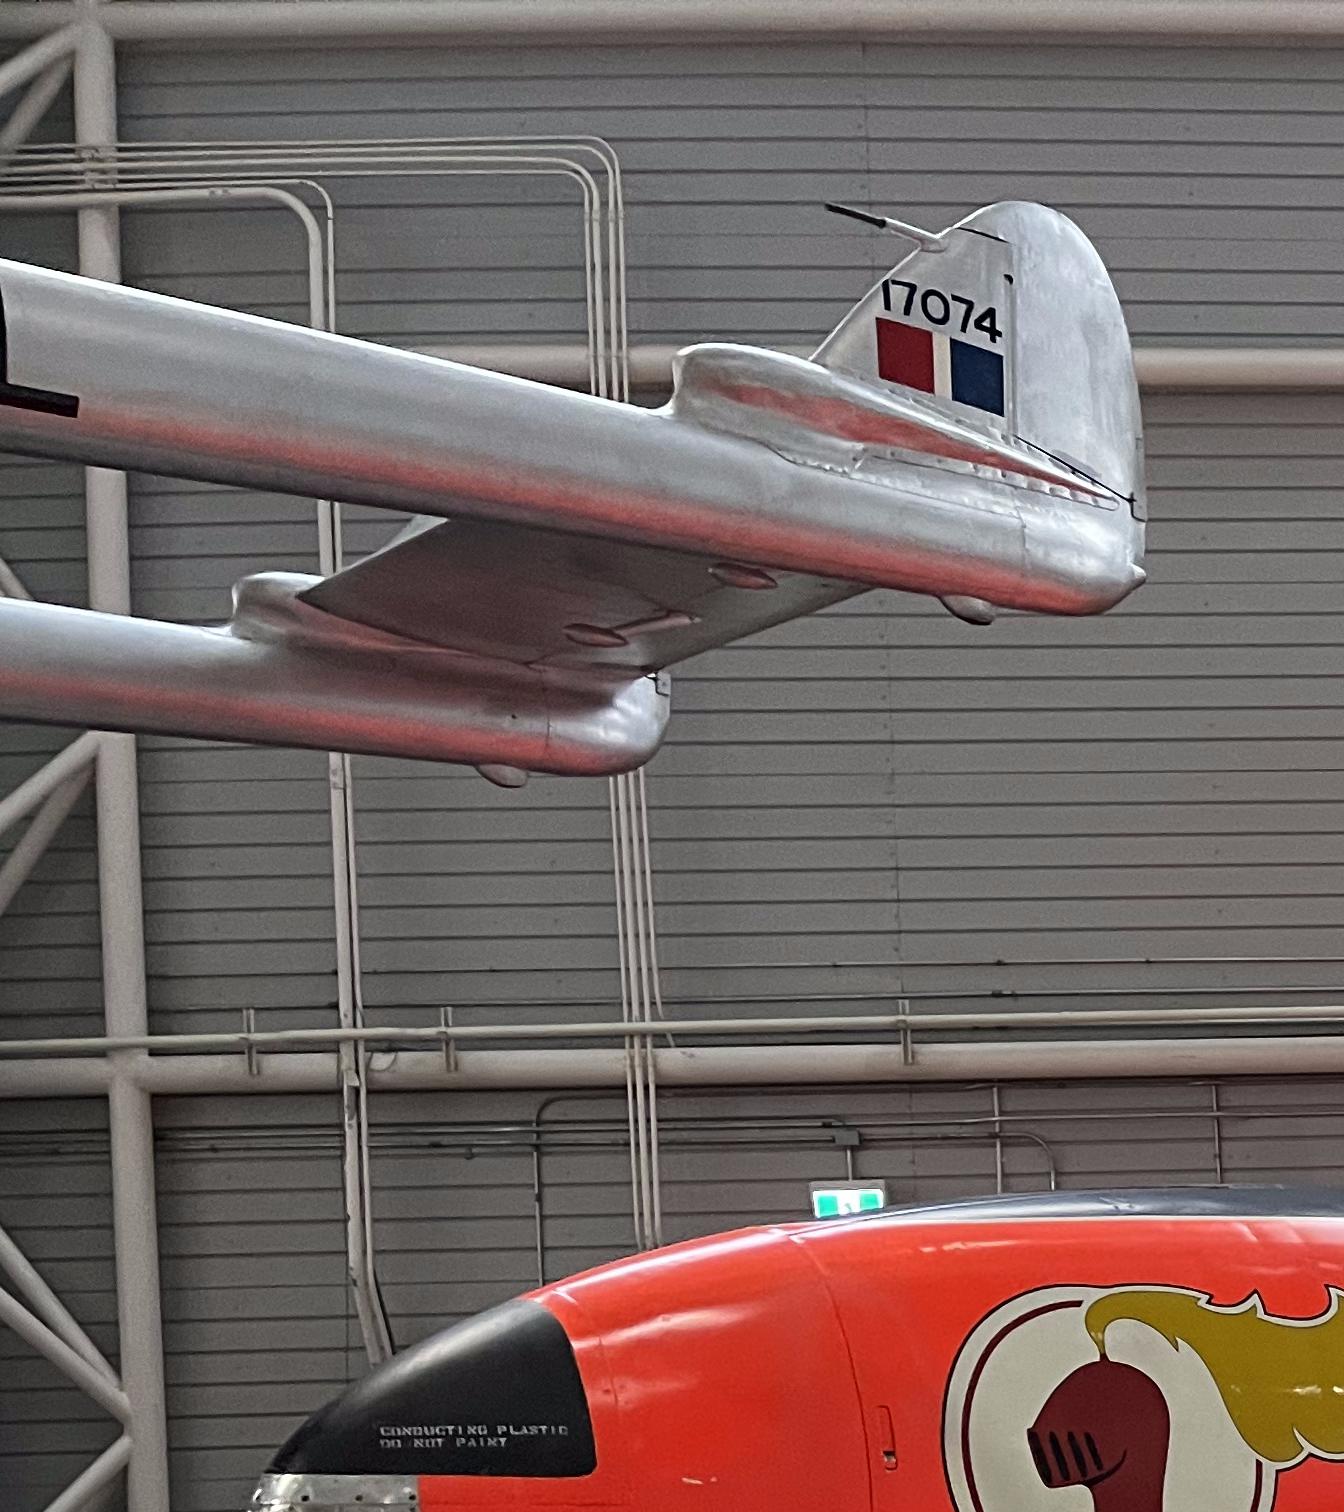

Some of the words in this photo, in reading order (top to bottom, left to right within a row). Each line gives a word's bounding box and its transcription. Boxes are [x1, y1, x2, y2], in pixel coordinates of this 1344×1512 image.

[881, 278, 1003, 343] 17074
[379, 1425, 488, 1436] CONDUCTING
[496, 1425, 569, 1436] PLASTIC
[413, 1437, 444, 1448] NOT
[455, 1437, 508, 1448] PAINT
